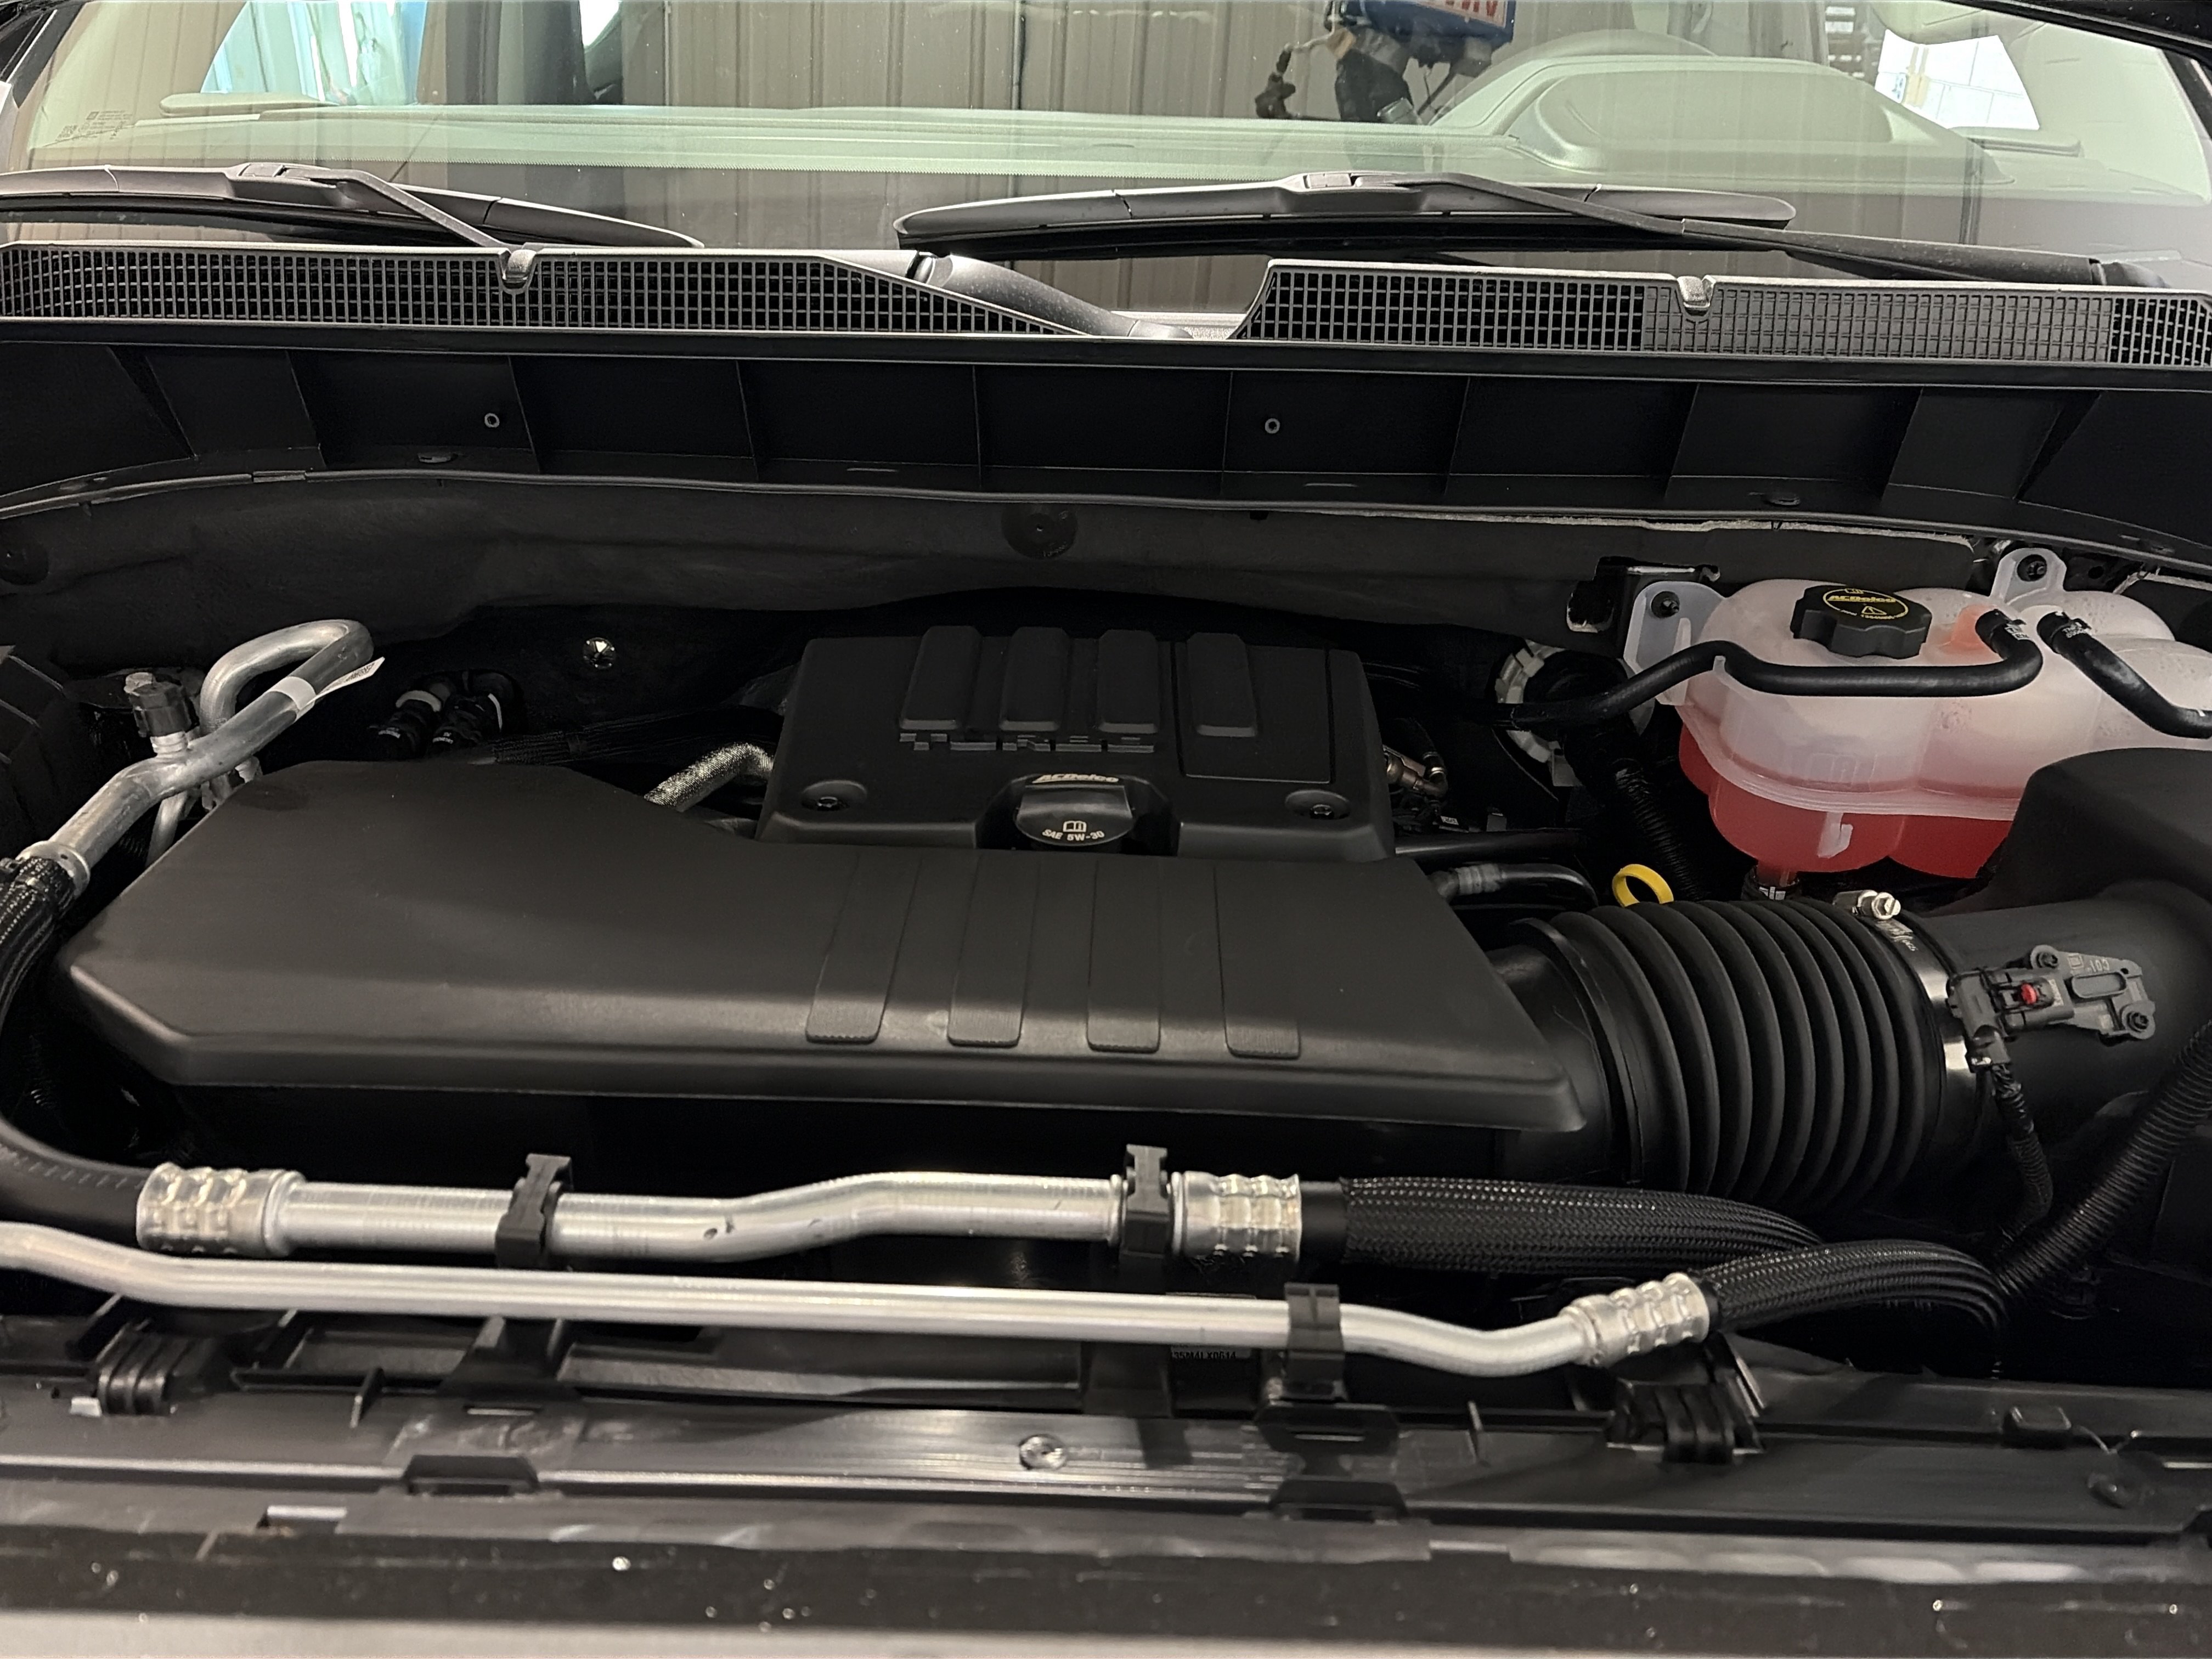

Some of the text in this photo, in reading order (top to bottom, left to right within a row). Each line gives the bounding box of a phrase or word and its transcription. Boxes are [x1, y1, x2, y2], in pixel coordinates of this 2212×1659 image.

[1032, 774, 1119, 783] ACDelco
[1042, 830, 1104, 840] SAE 5W-30
